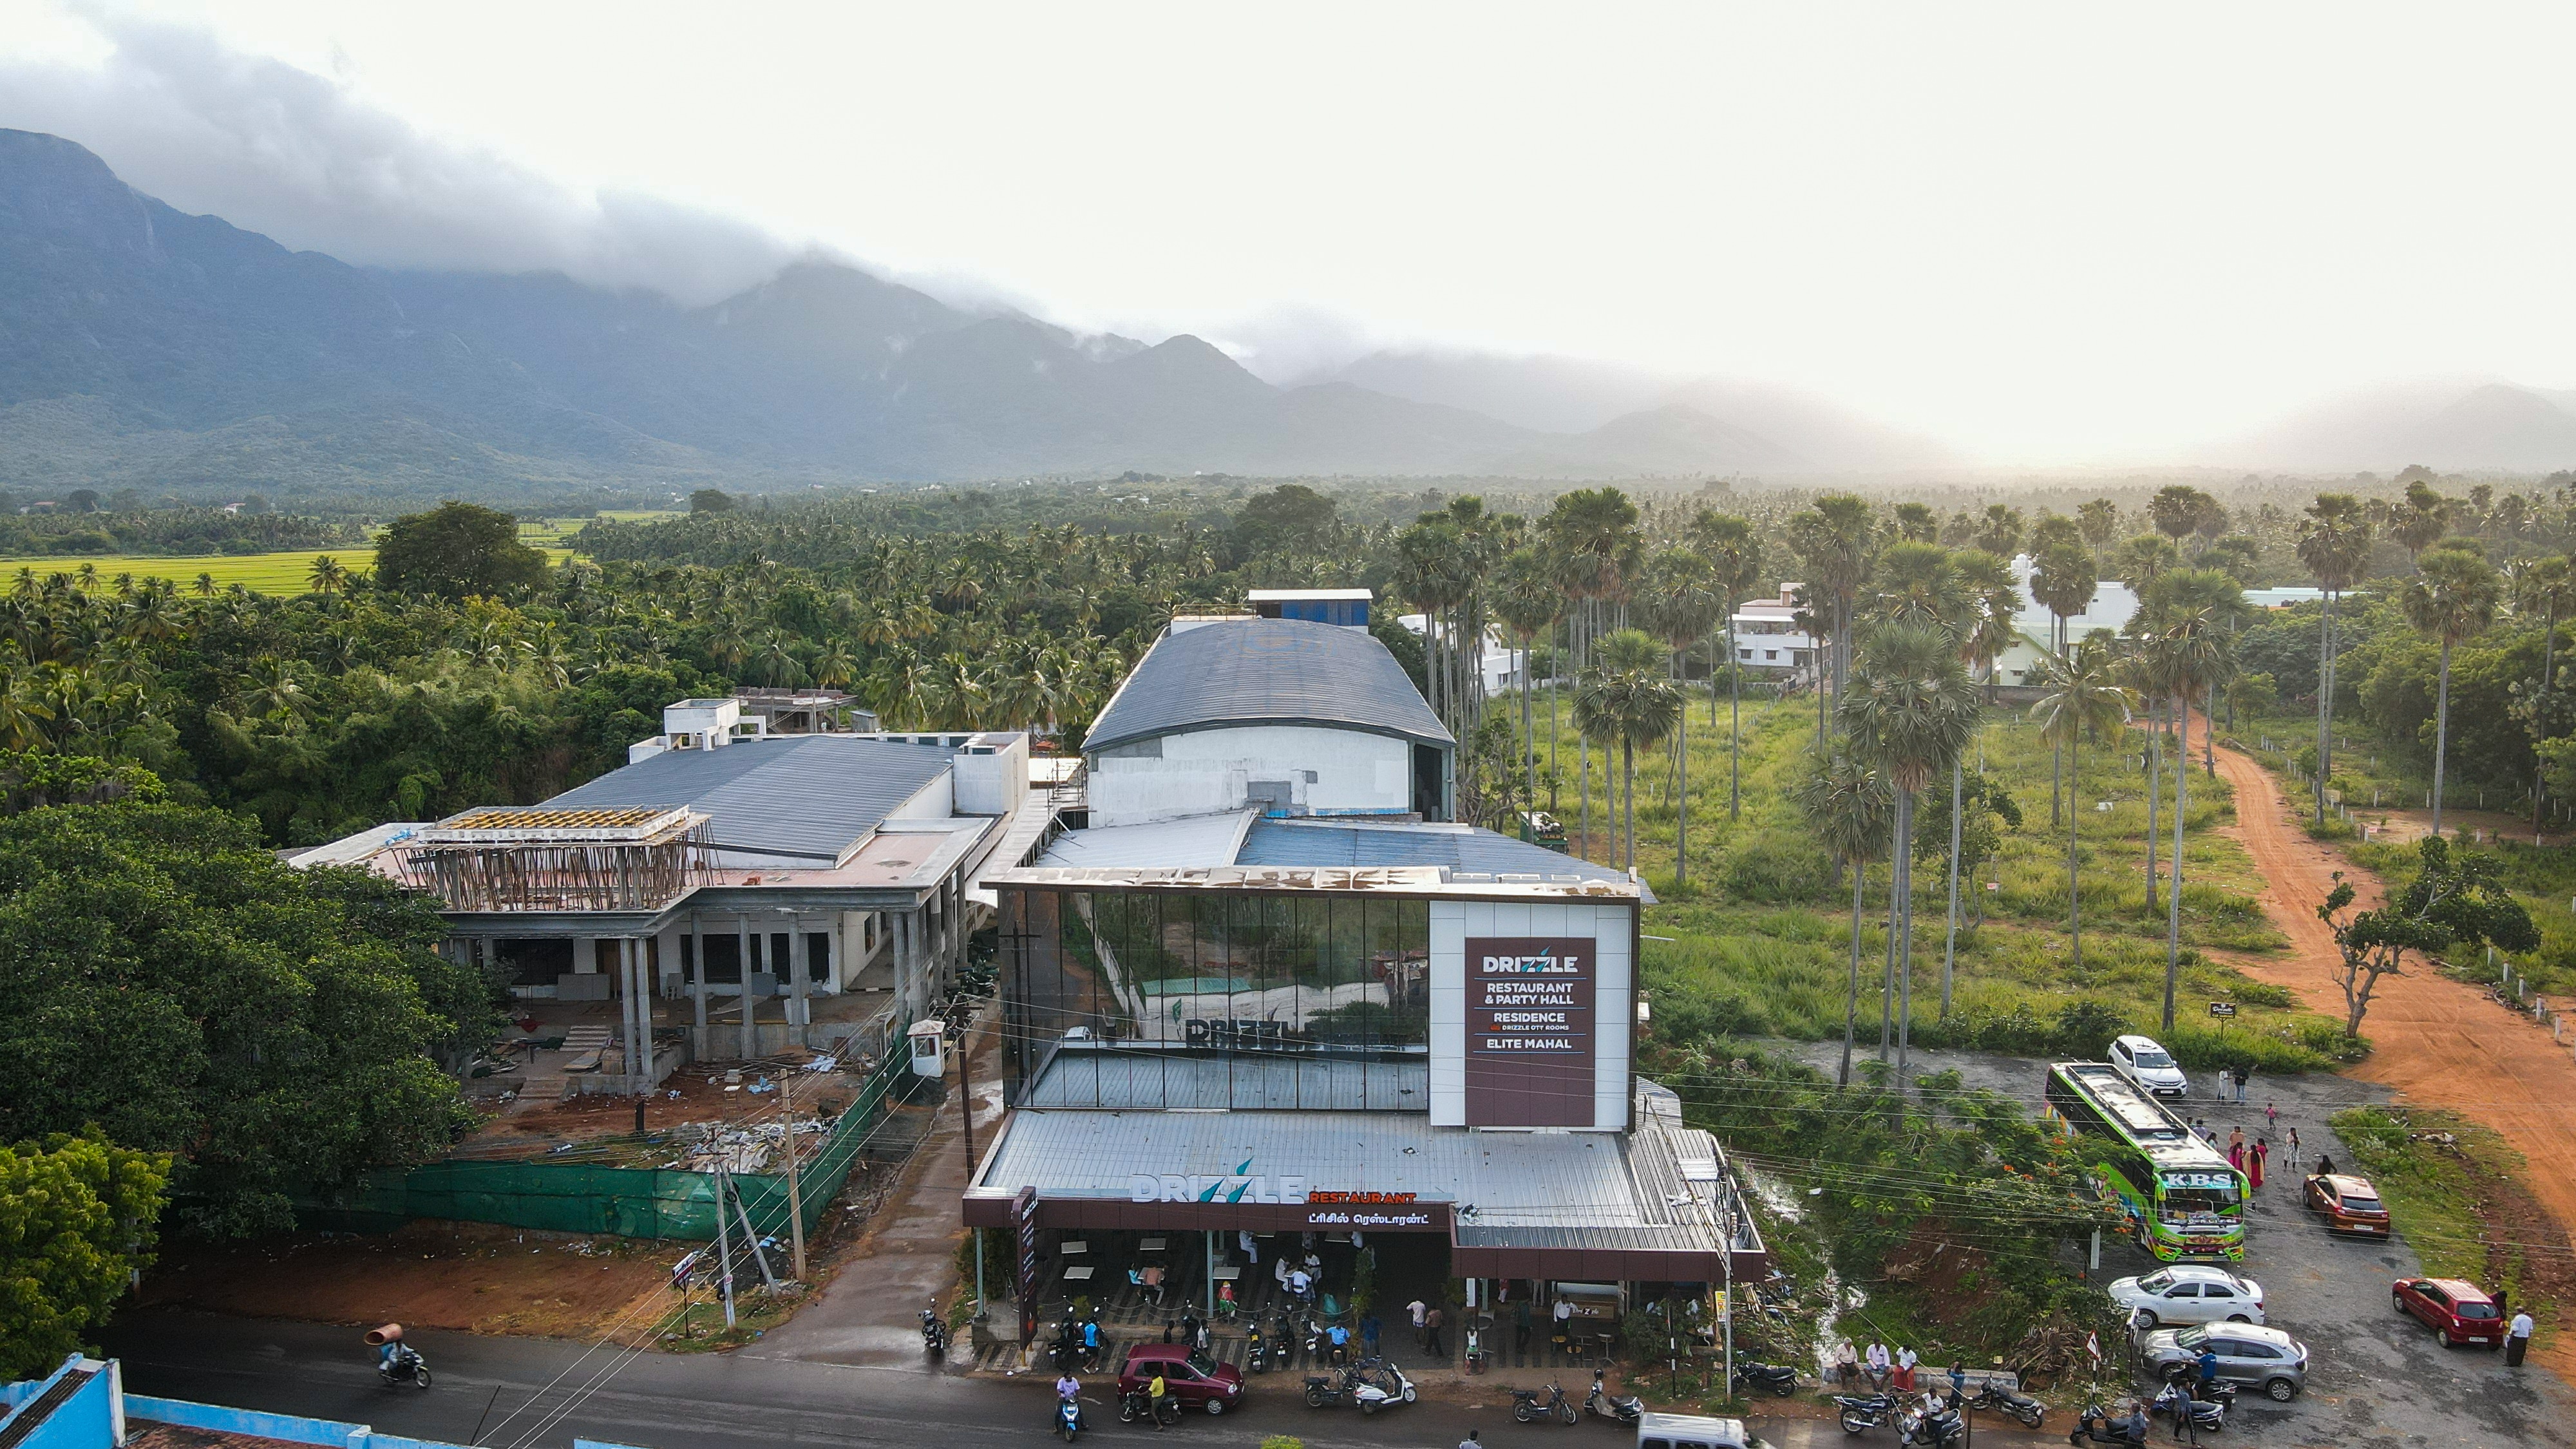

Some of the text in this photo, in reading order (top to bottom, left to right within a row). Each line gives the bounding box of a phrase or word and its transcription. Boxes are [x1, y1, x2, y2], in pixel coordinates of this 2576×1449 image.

[1483, 956, 1578, 973] DRIZZLE
[1487, 983, 1573, 993] RESTAURANT
[1485, 994, 1574, 1005] & PARTY HALL
[1493, 1012, 1566, 1023] RESIDENCE
[1486, 1039, 1572, 1049] ELITE MAHAL
[2165, 1173, 2231, 1186] KBS
[1132, 1174, 1305, 1204] DRIZZLE
[1309, 1192, 1417, 1204] RESTAURANT
